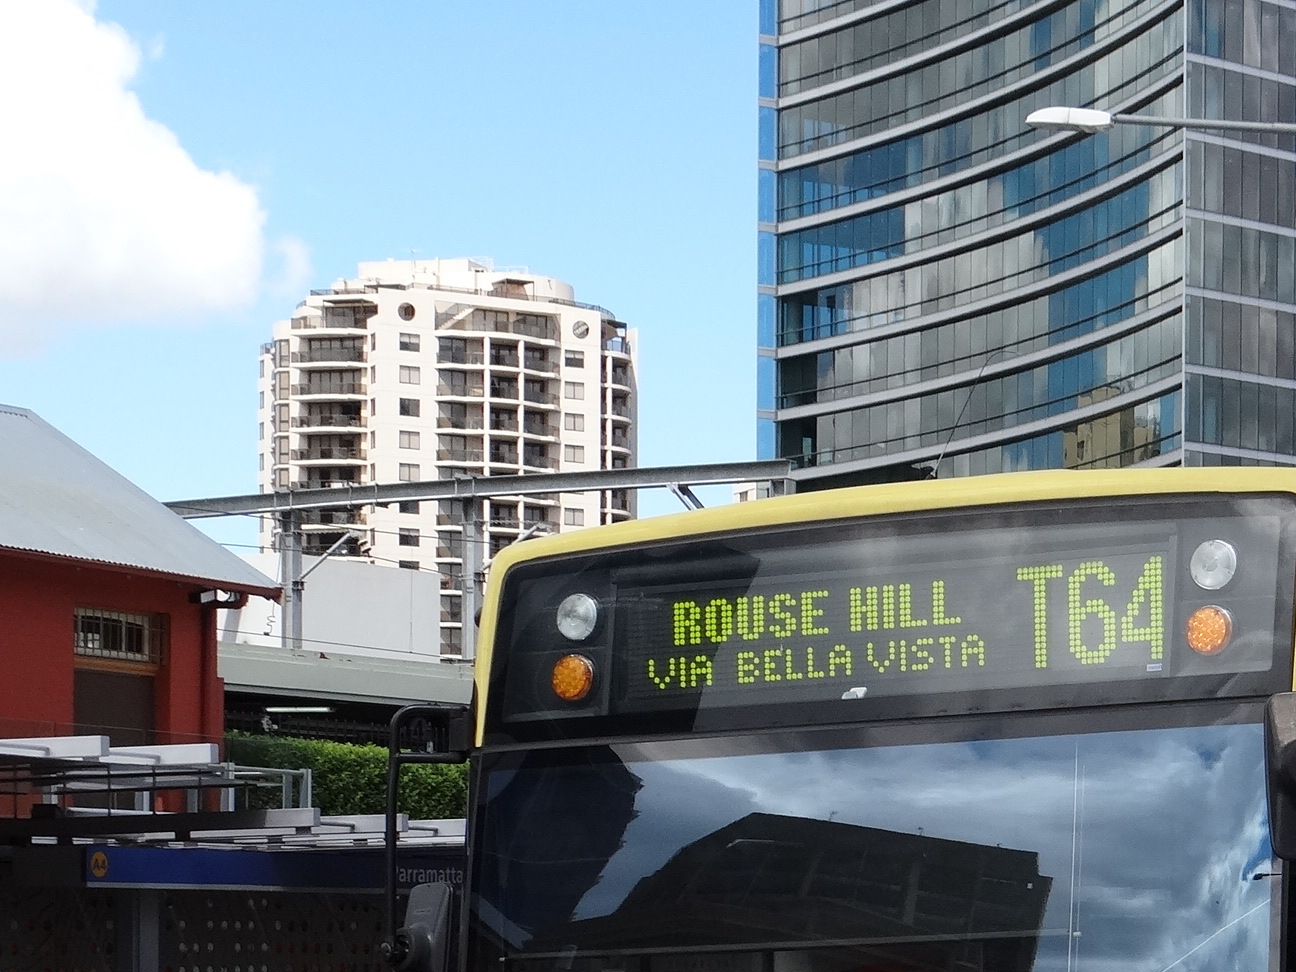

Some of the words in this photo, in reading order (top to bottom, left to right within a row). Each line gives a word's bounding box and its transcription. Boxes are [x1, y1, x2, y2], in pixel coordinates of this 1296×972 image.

[673, 589, 829, 646] ROUSE
[849, 580, 961, 632] HILL
[1016, 555, 1163, 669] T64
[648, 655, 713, 690] VIA
[737, 644, 852, 684] BELLA
[866, 634, 985, 674] VISTA
[396, 865, 463, 884] arramatta
